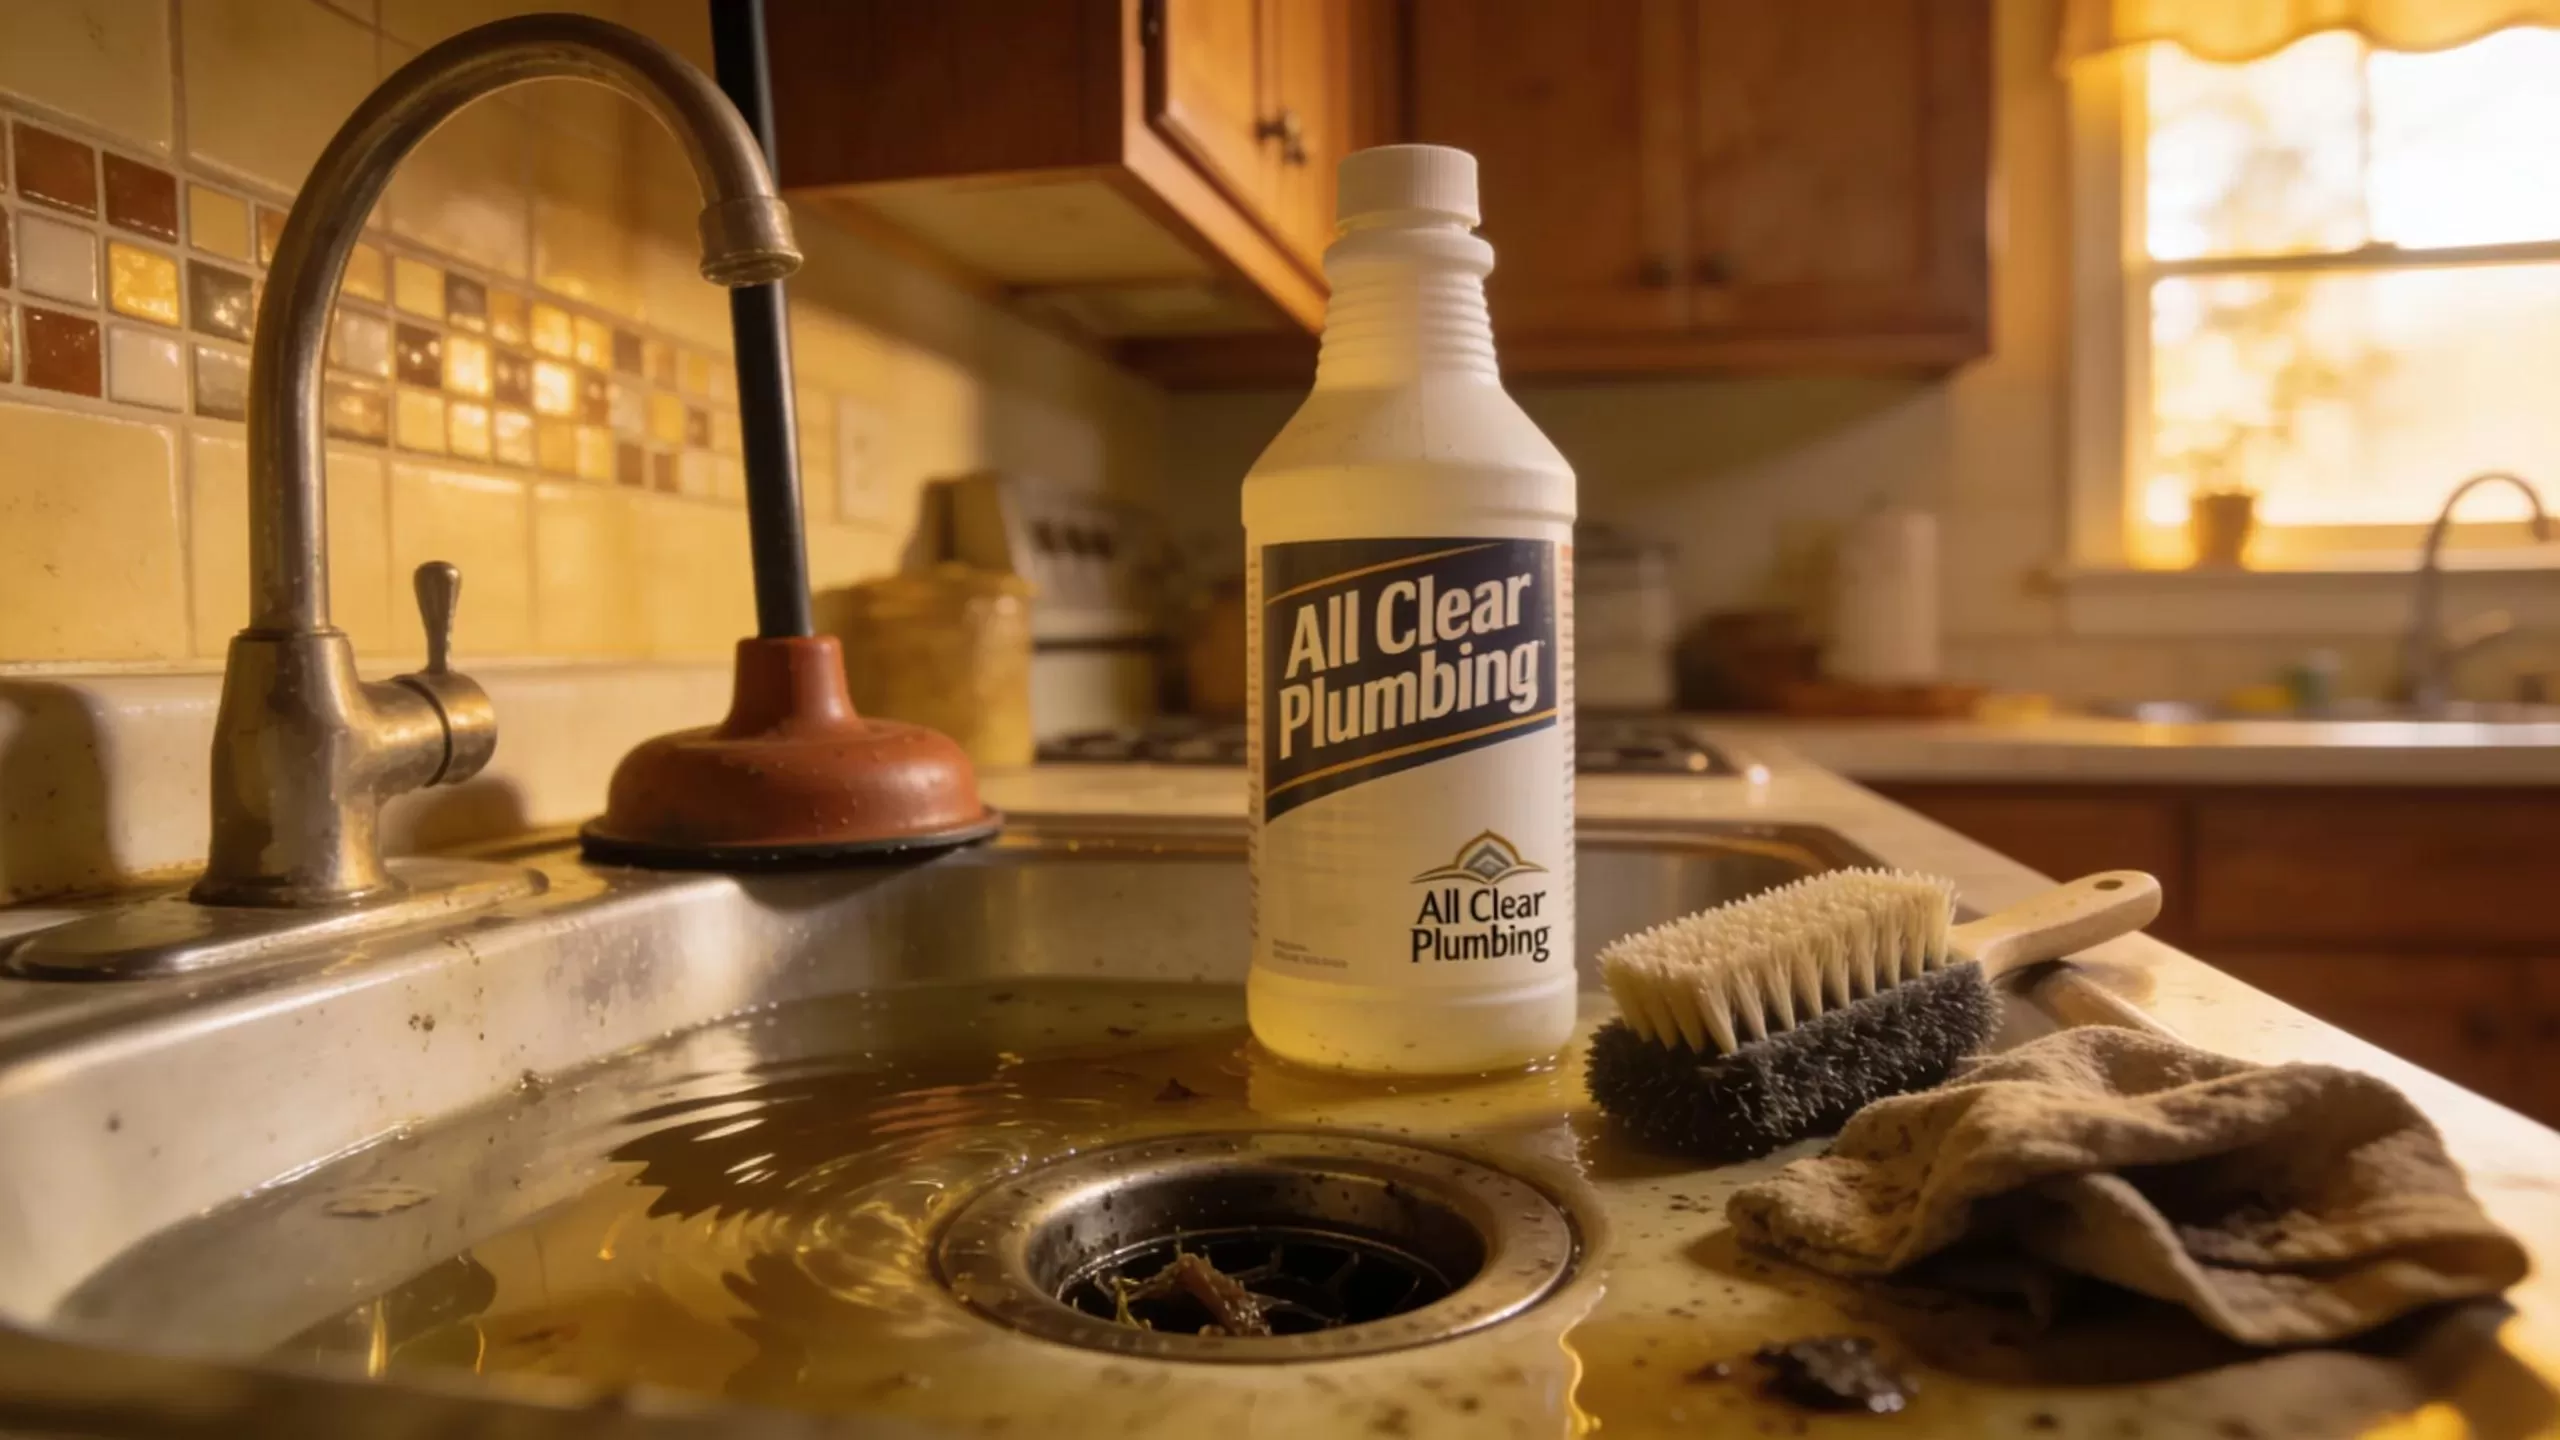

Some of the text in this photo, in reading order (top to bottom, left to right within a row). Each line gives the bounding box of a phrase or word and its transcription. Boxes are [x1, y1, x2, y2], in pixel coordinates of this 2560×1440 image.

[1285, 573, 1532, 679] All Clear
[1279, 640, 1539, 760] Plumbing
[1416, 888, 1546, 924] All Clear
[1410, 924, 1551, 963] Plumbing
